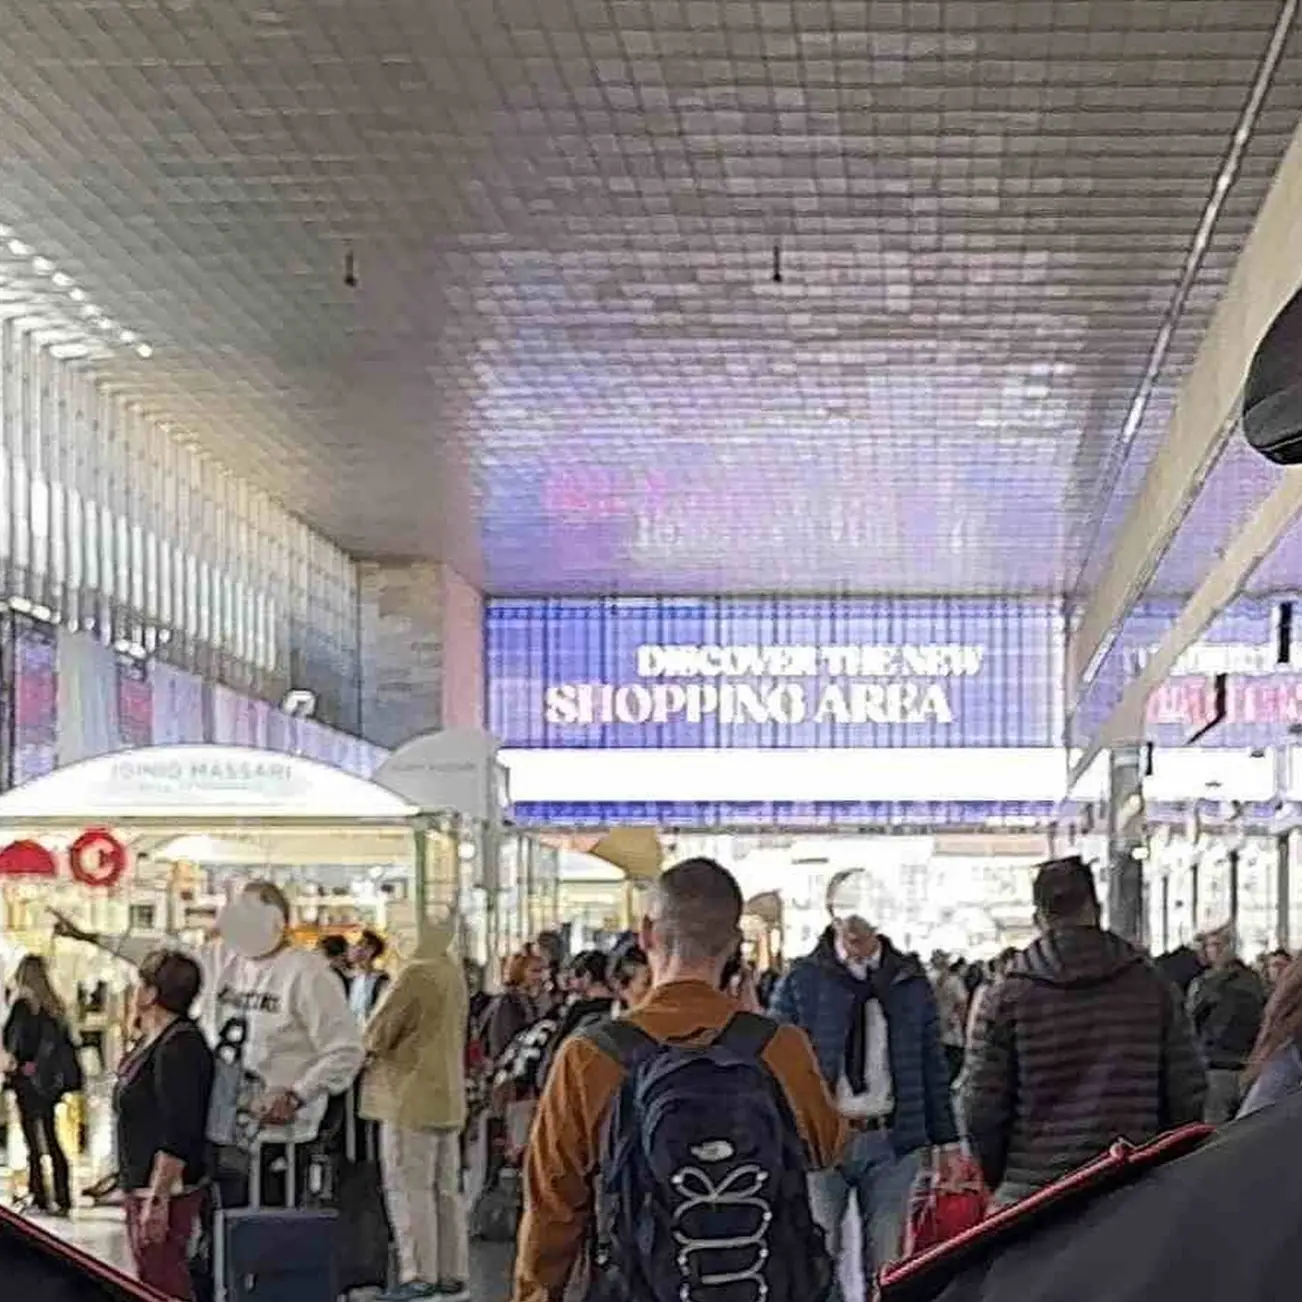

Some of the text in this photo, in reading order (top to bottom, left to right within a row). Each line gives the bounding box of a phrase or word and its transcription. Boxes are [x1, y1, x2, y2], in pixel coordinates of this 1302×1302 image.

[637, 643, 984, 677] DISCOVER THE NEW
[546, 683, 953, 724] SHOPPING AREA
